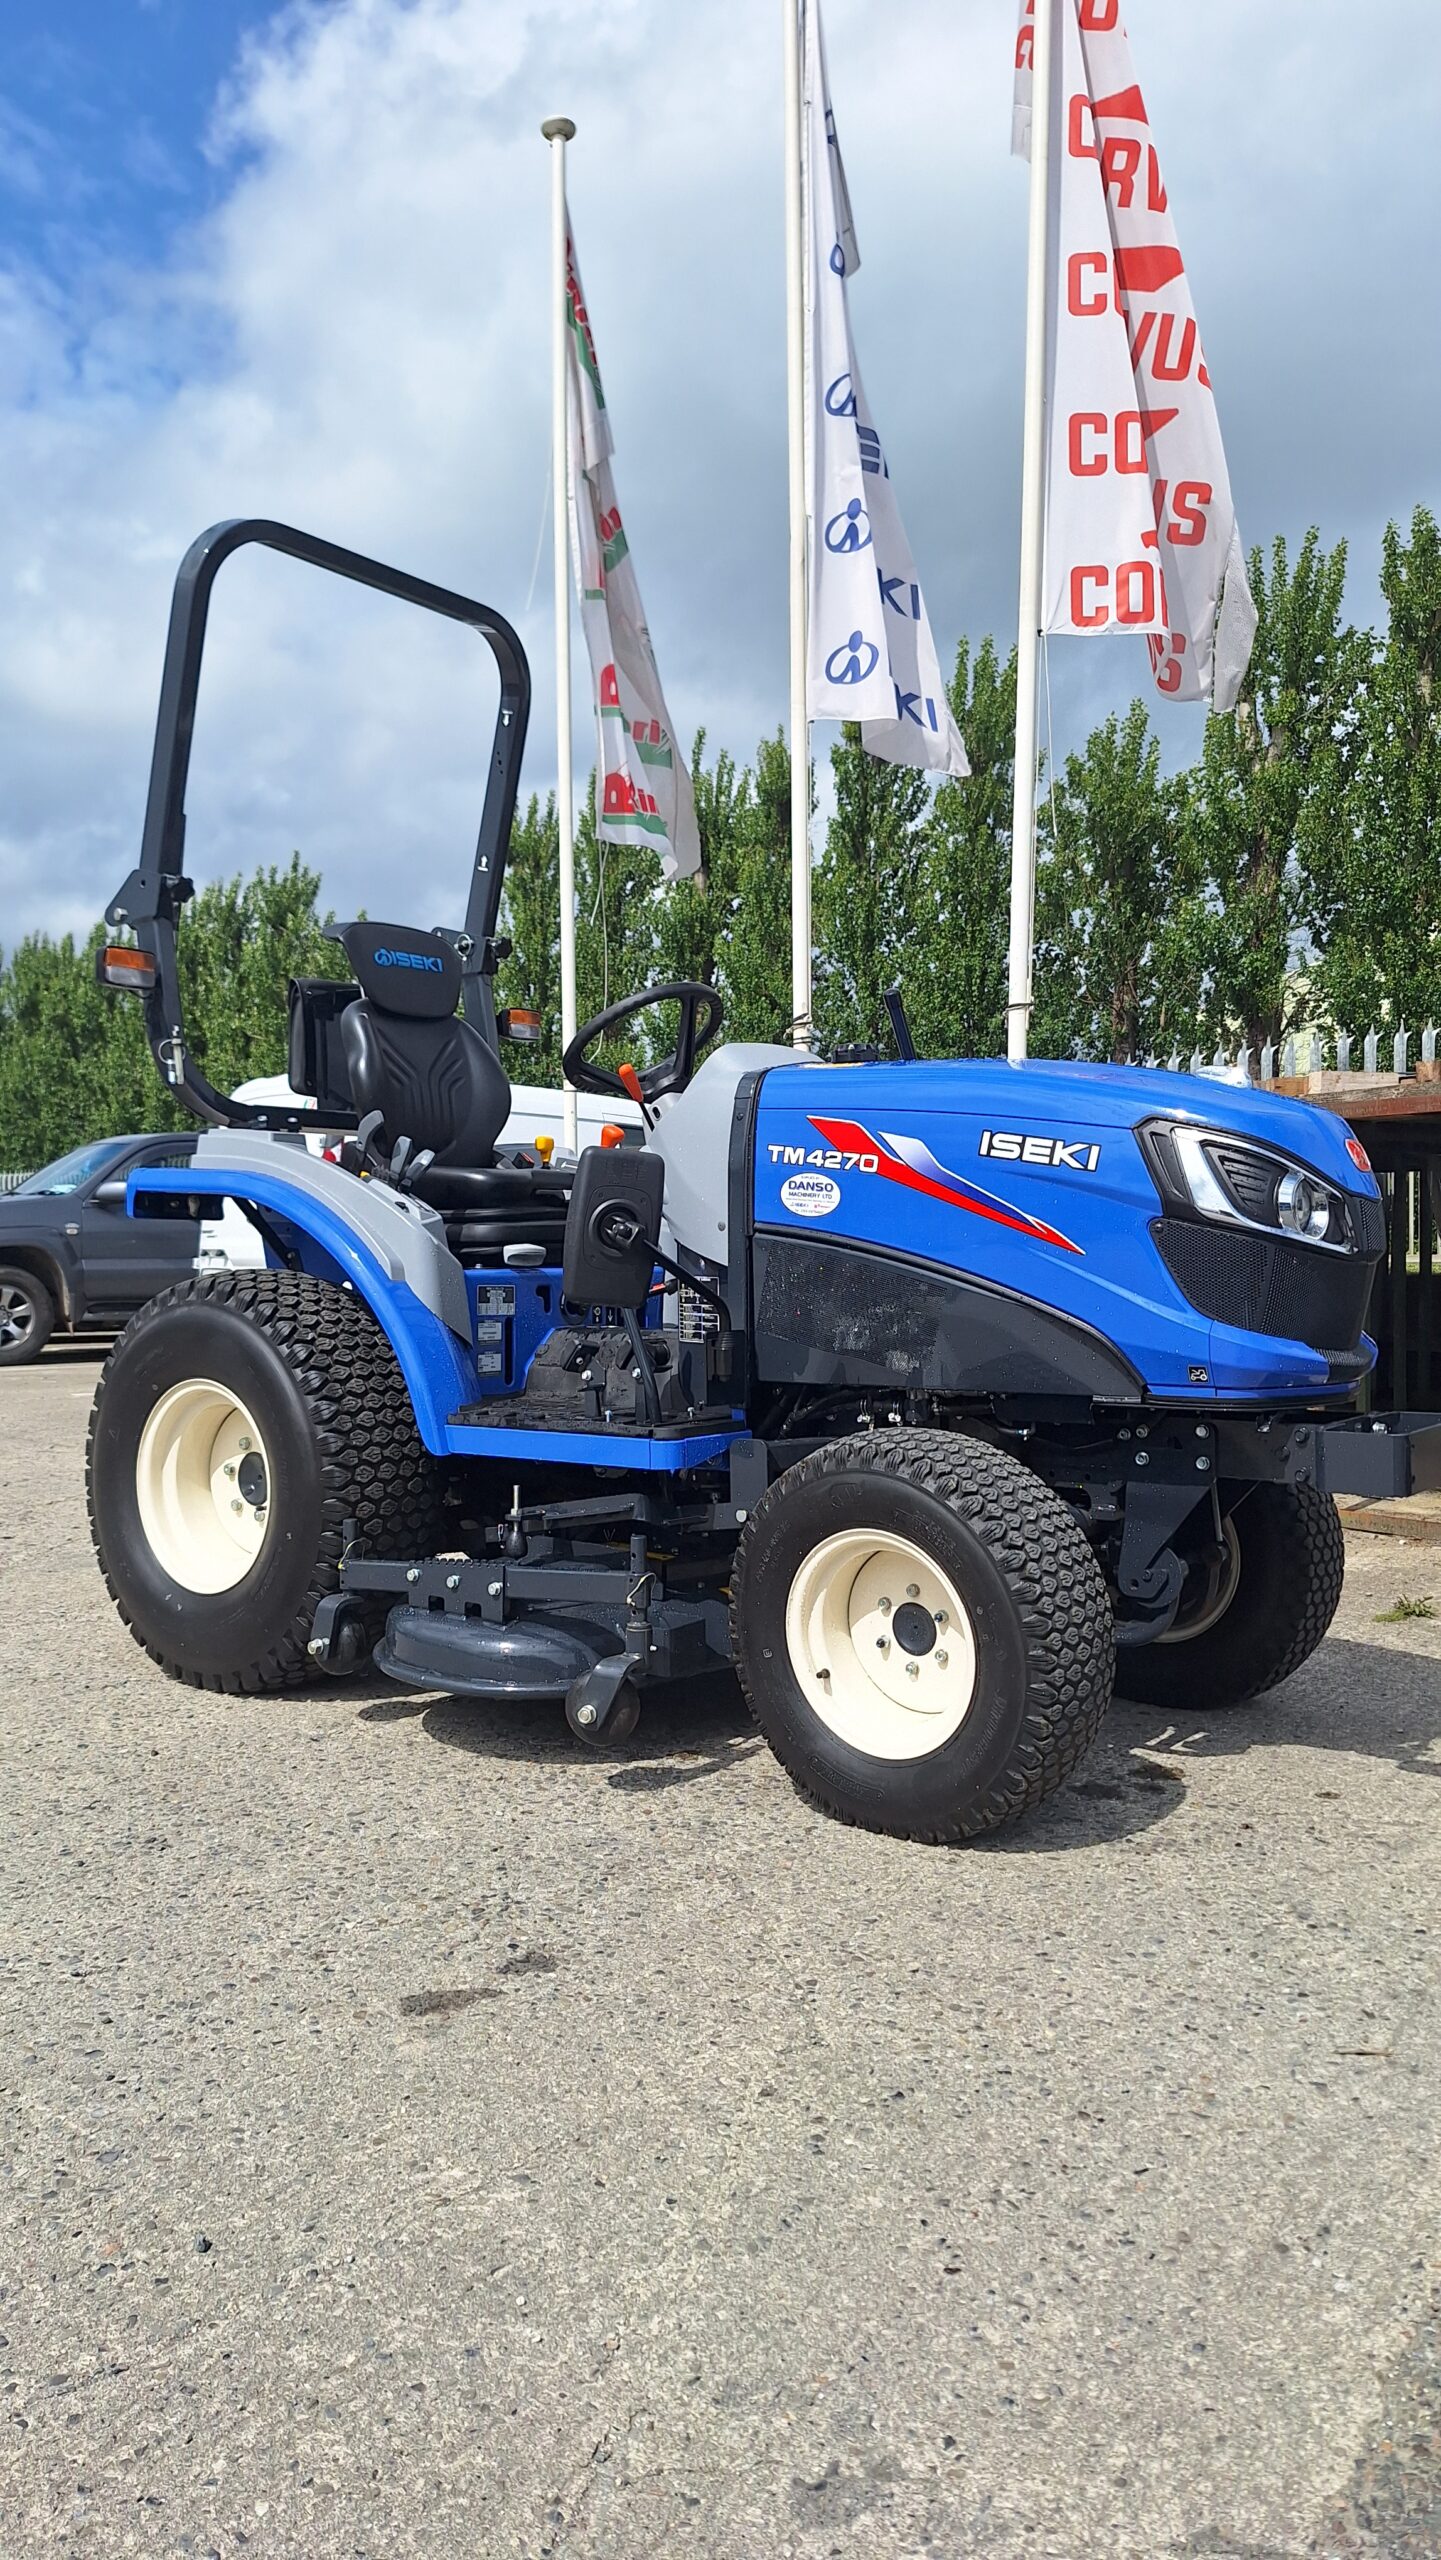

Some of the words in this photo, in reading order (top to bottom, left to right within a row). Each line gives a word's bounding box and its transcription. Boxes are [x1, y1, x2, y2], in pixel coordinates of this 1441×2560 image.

[389, 950, 443, 973] ISEKI
[767, 1144, 880, 1174] TM4270
[979, 1129, 1102, 1172] ISEKI
[788, 1180, 835, 1193] DANSO
[788, 1191, 821, 1199] MACHINERY
